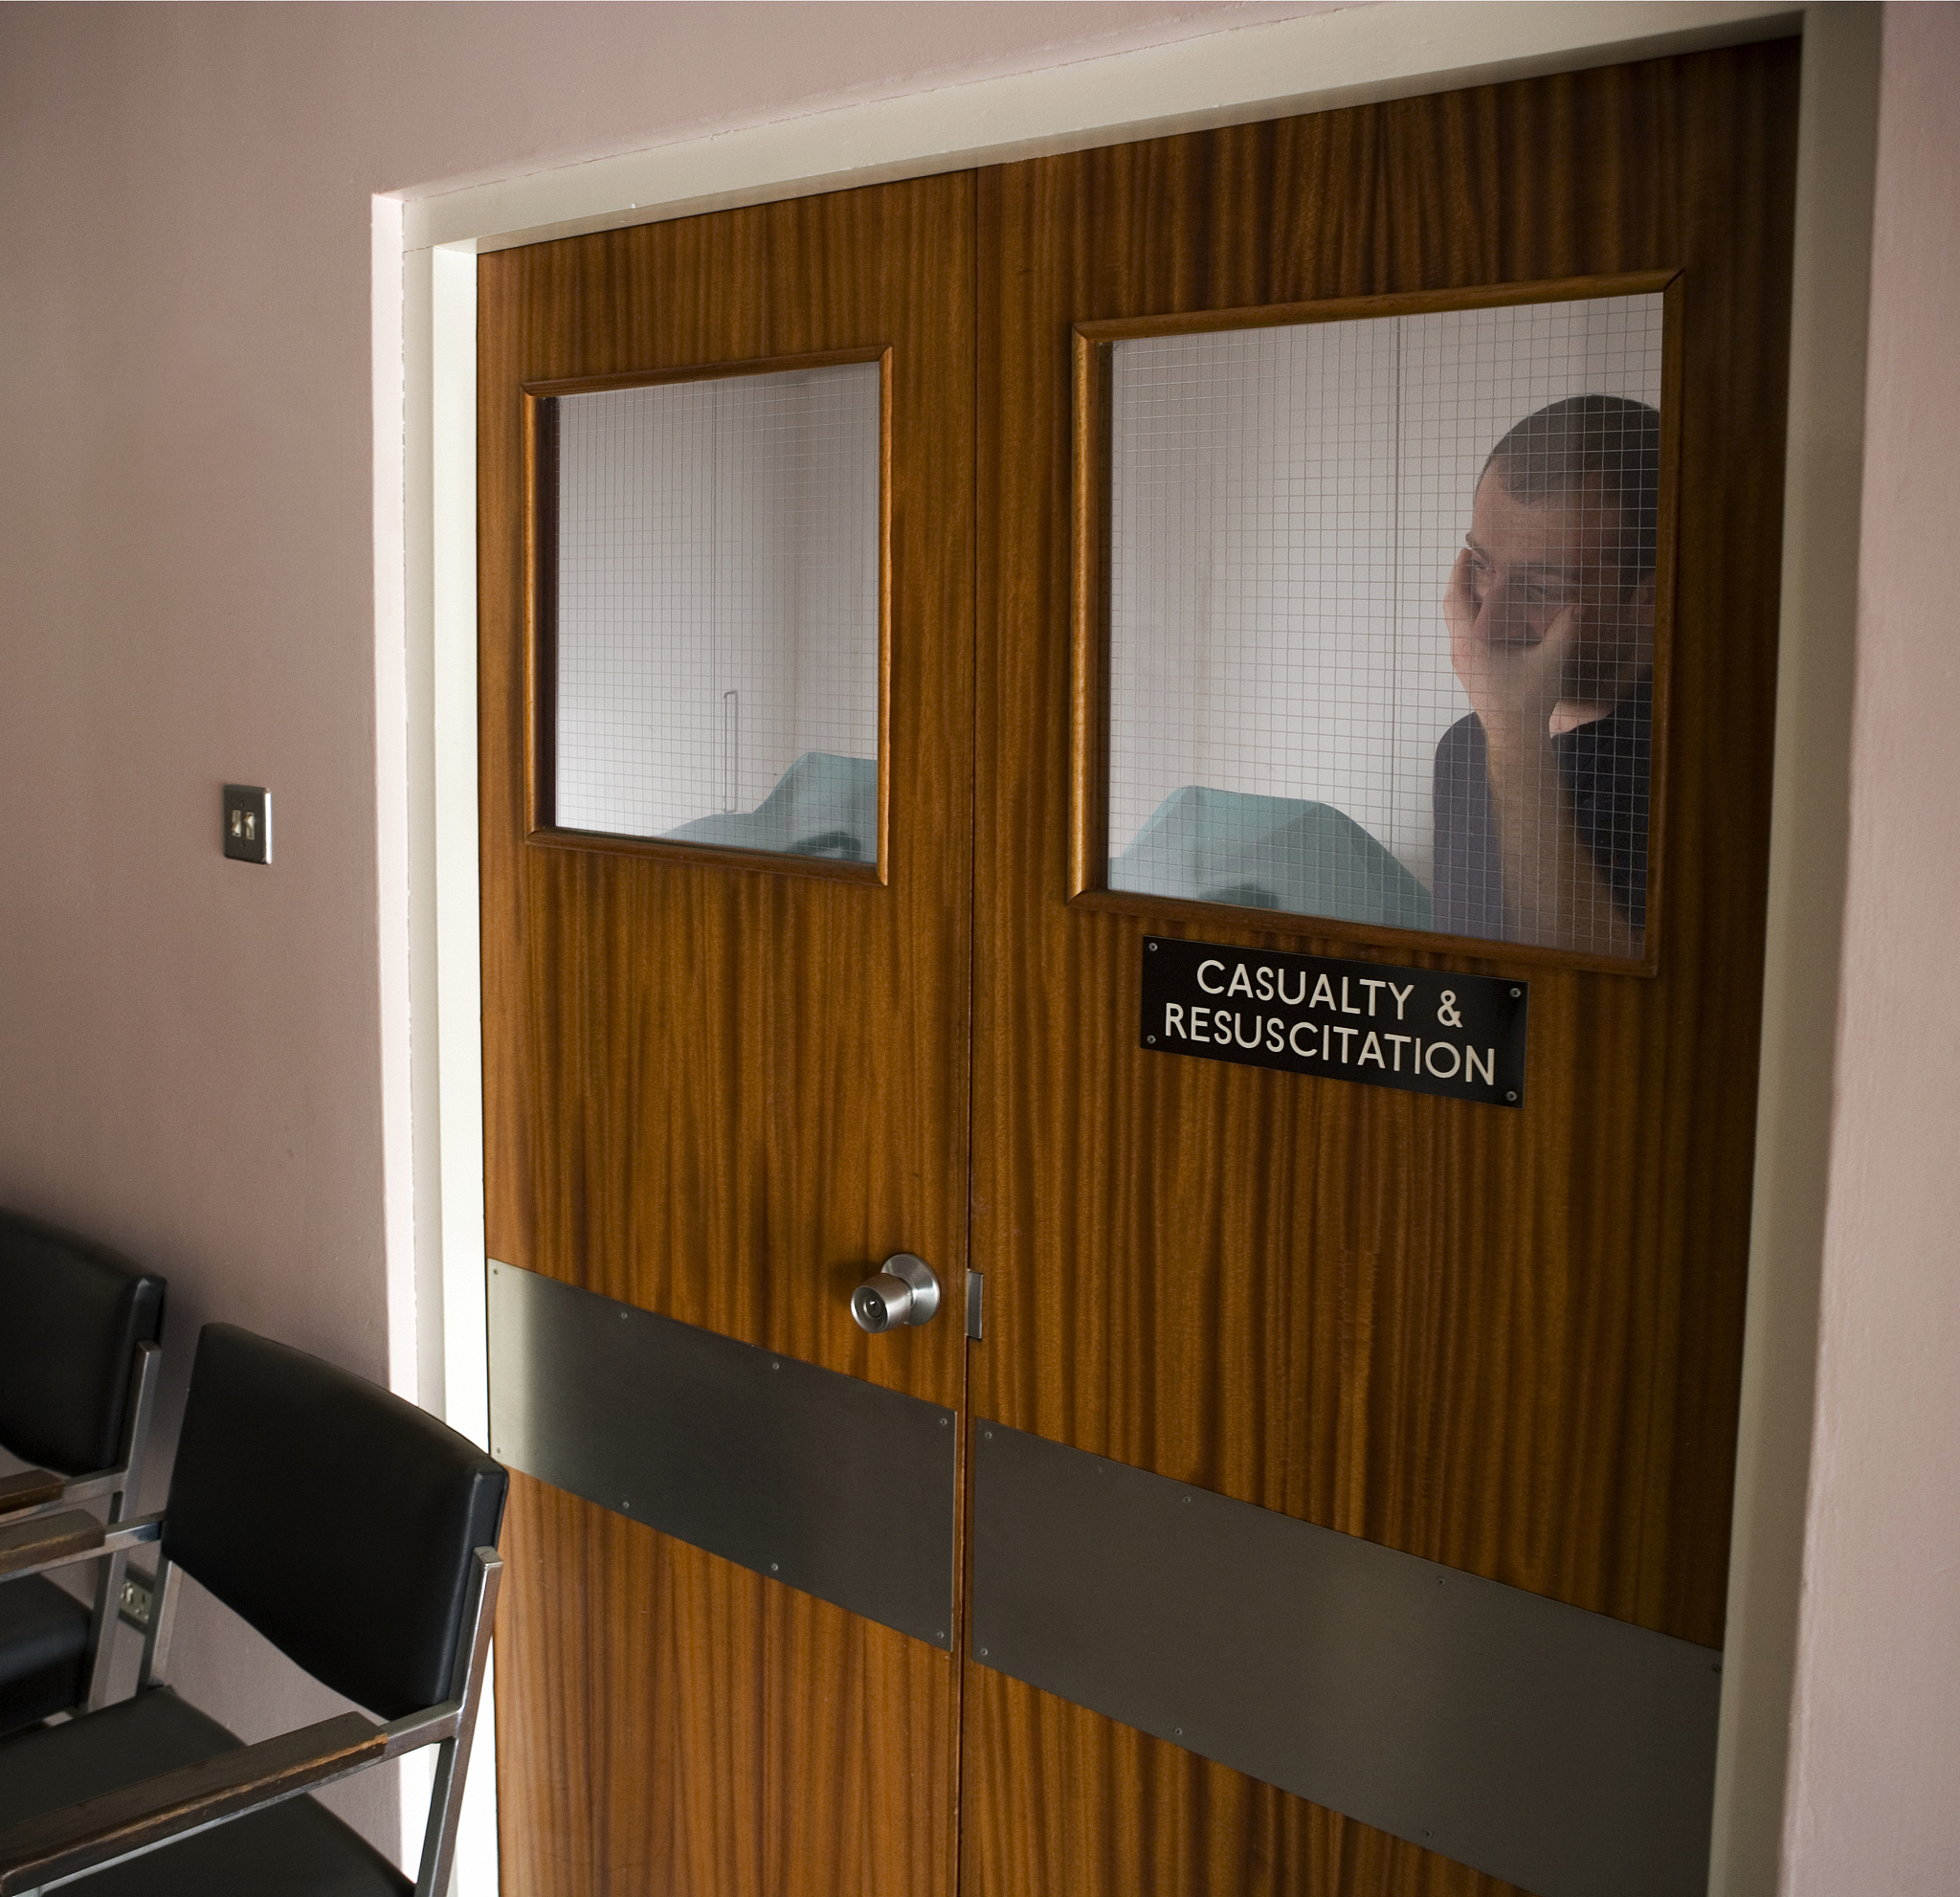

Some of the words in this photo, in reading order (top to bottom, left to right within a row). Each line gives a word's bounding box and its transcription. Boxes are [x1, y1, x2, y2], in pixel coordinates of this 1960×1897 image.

[1196, 959, 1414, 1020] CASUALTY
[1437, 990, 1463, 1028] &
[1165, 1002, 1495, 1085] RESUSCITATION
